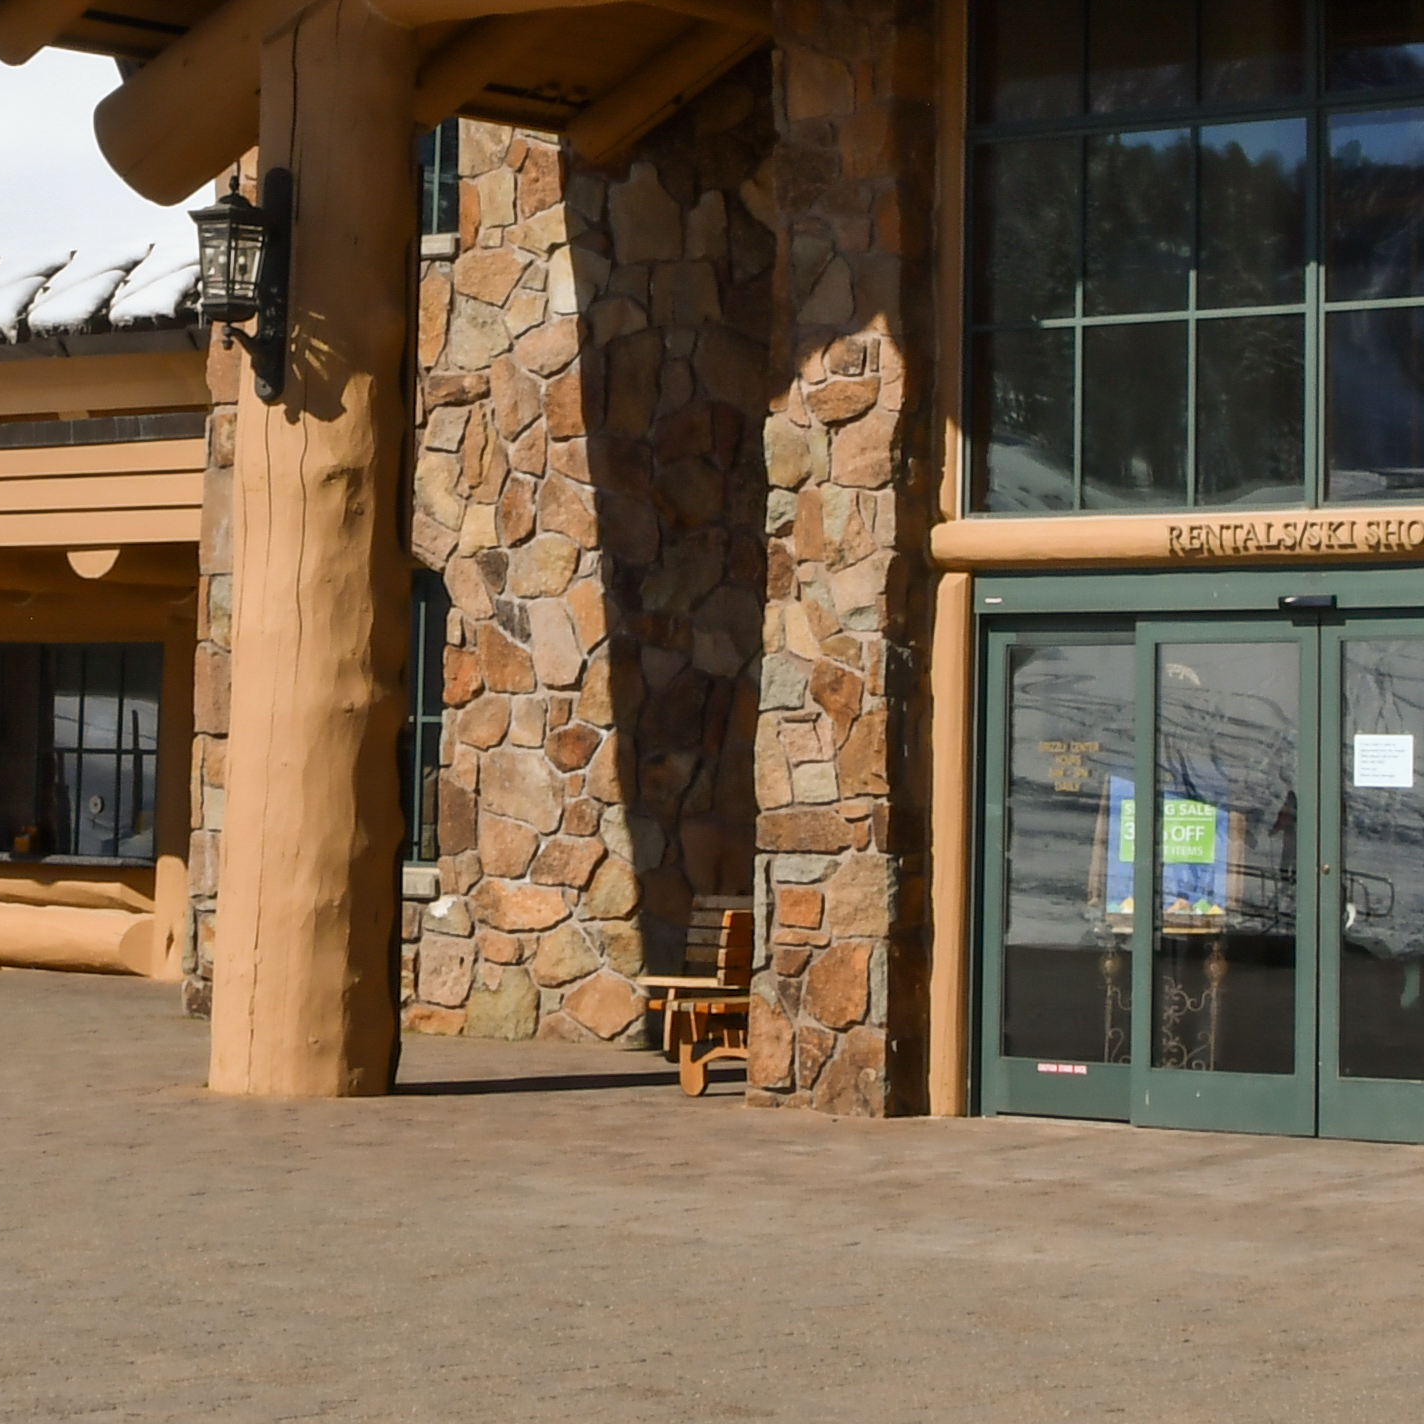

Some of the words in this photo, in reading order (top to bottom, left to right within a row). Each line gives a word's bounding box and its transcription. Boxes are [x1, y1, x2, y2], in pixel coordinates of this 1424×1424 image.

[1167, 519, 1358, 553] RENTALS/SKI
[1178, 803, 1213, 816] SALE
[1170, 824, 1206, 842] OFF
[1171, 845, 1204, 856] ITEMS
